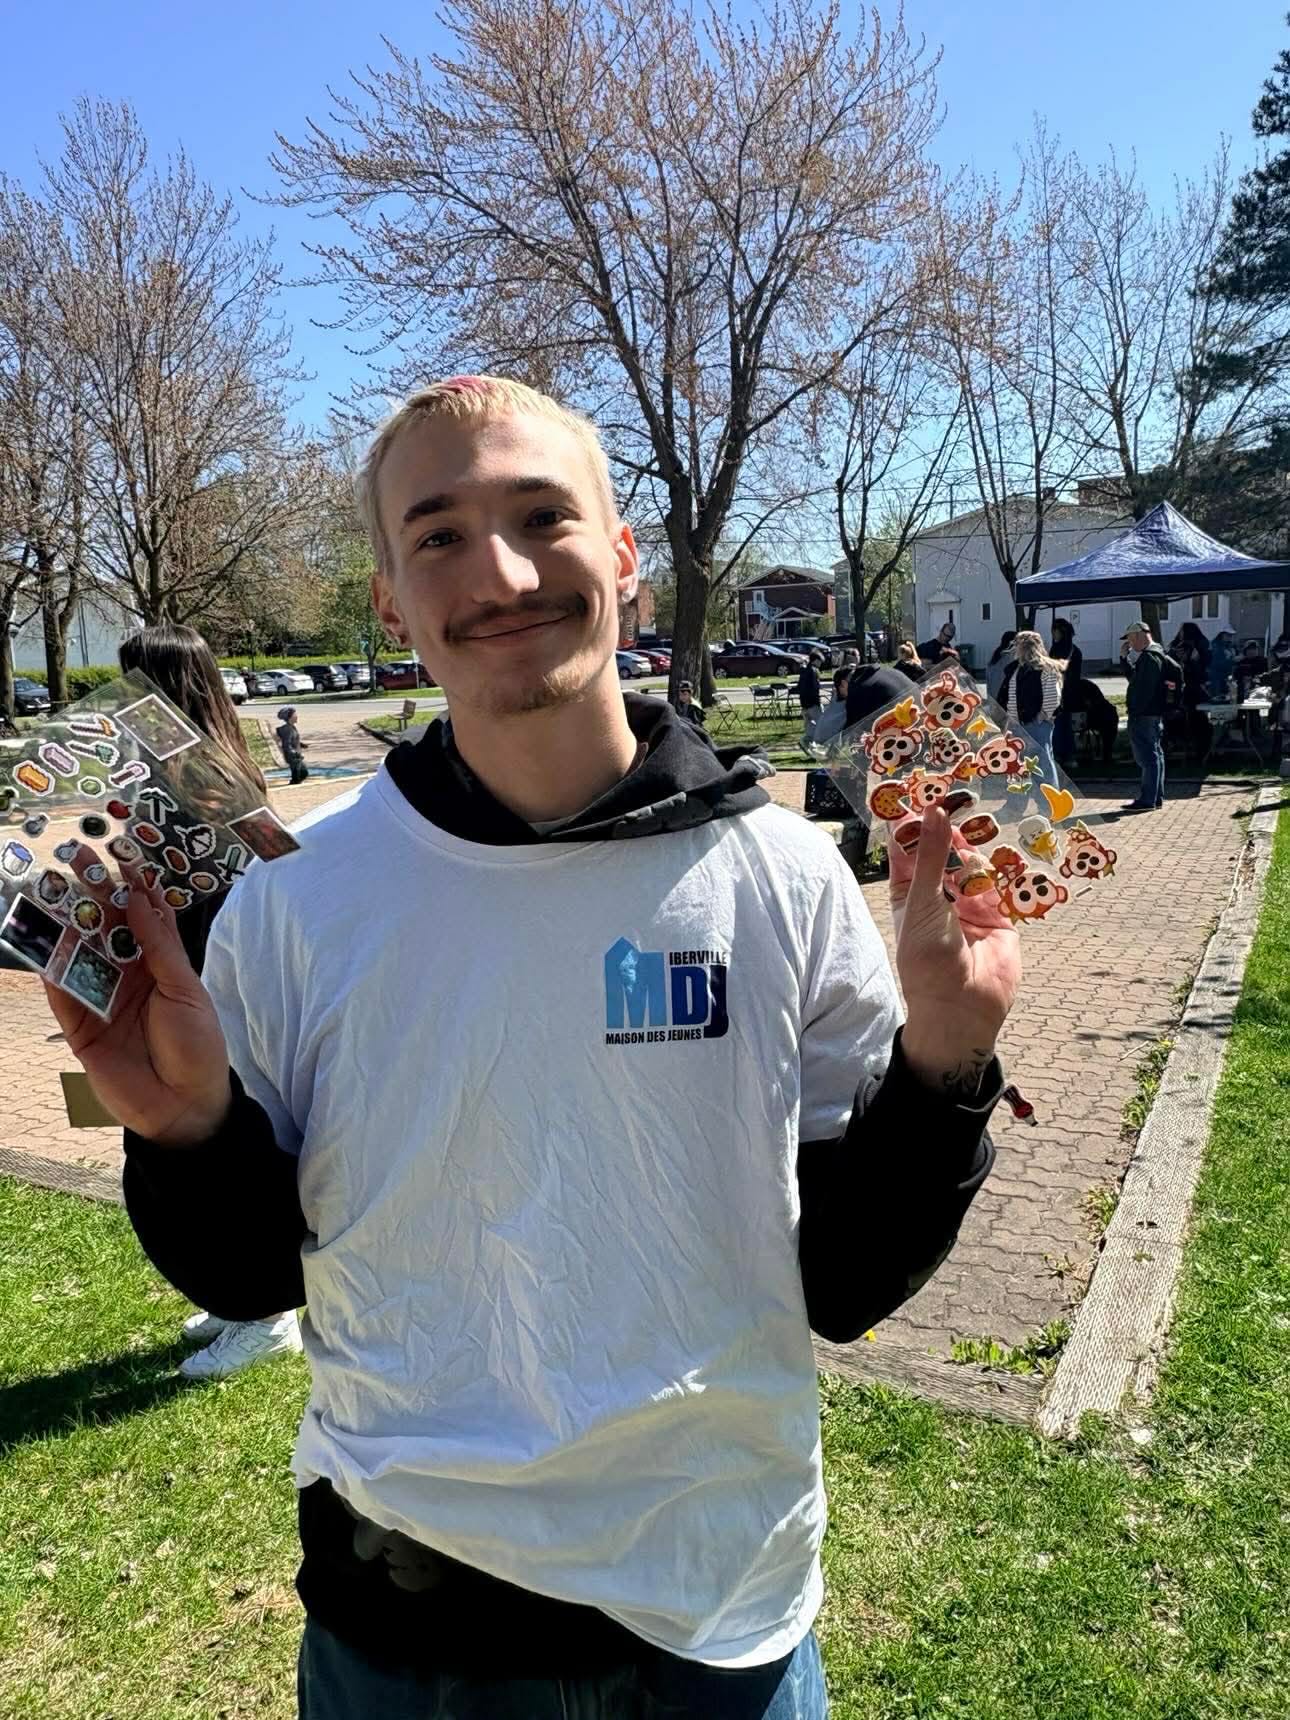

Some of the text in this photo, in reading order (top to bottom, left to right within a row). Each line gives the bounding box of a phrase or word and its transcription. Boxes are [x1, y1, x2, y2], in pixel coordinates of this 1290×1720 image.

[669, 950, 727, 965] IBERVILLE
[604, 936, 729, 1038] MDJ
[606, 1028, 701, 1044] MAISON DES JEUNES
